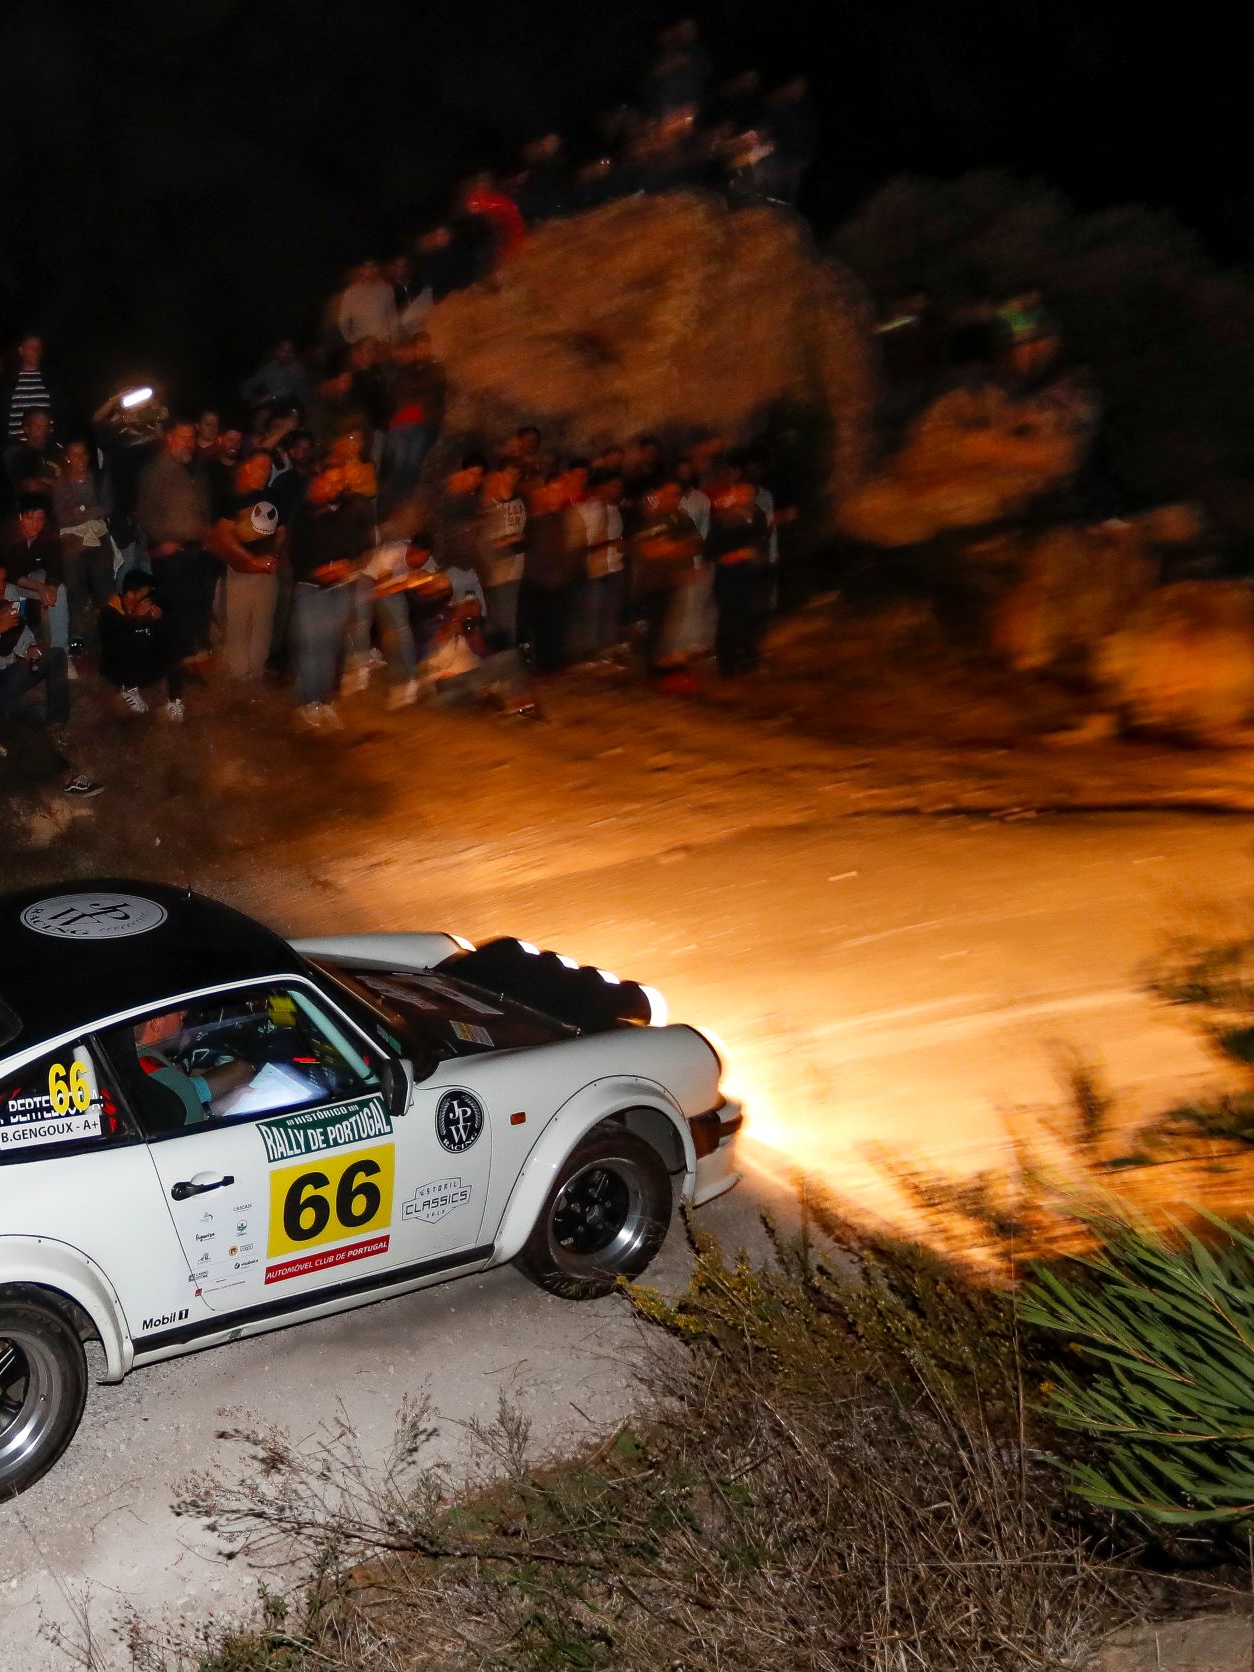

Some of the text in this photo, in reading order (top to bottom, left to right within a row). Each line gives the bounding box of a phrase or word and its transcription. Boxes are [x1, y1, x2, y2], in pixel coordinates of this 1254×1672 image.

[48, 1060, 91, 1114] 66
[258, 1097, 391, 1160] RALLY DE PORTUGAL
[294, 1106, 347, 1125] HISTÓRICO
[1, 1121, 74, 1143] B.GENGOUX
[83, 1119, 99, 1131] A+
[442, 1131, 478, 1151] RACING
[283, 1158, 382, 1242] 66
[405, 1190, 468, 1216] CLASSICS
[266, 1241, 388, 1280] AUTOMÓVEL CLUB DE PORTUGAL
[141, 1311, 177, 1331] Mobil
